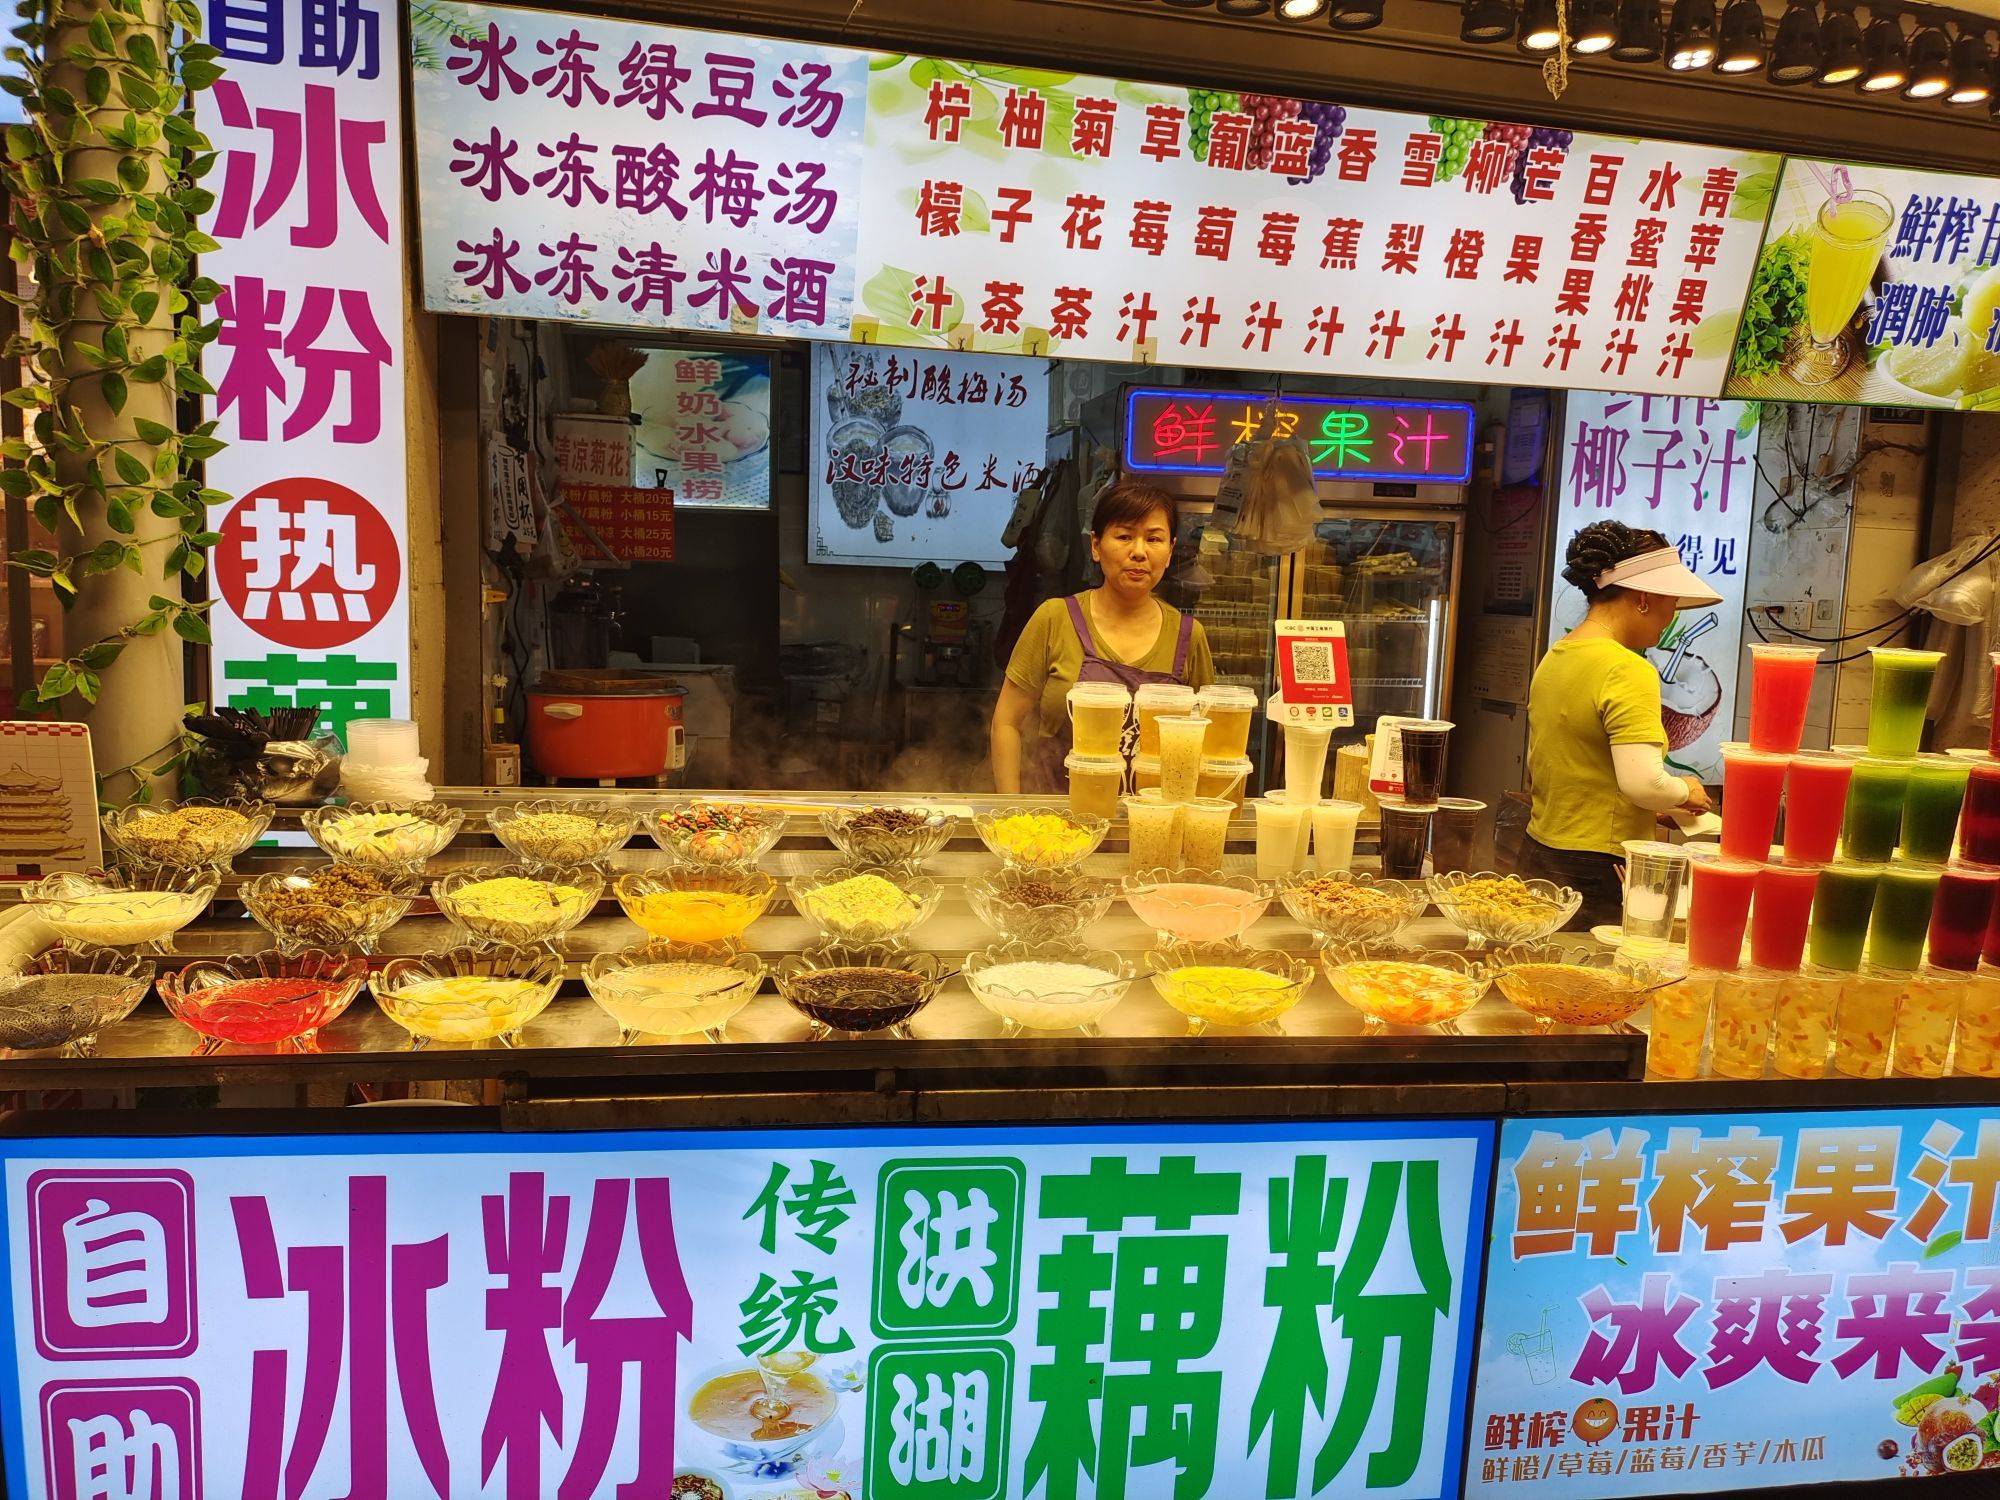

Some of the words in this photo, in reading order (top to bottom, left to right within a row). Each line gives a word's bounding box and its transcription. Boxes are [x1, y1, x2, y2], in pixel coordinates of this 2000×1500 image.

[209, 0, 380, 80] 自助
[447, 22, 844, 138] 冰冻绿豆汤
[210, 83, 393, 444] 冰粉
[449, 127, 838, 234] 冰冻酸梅汤
[452, 227, 836, 326] 冰冻清米酒
[909, 81, 971, 331] 柠檬汁
[980, 88, 1046, 335] 柚子茶
[1050, 97, 1117, 340] 菊花茶
[1117, 105, 1185, 344] 草莓汁
[1181, 113, 1251, 348] 葡萄汁
[1243, 120, 1317, 352] 蓝莓汁
[1304, 128, 1377, 356] 香蕉汁
[1366, 134, 1441, 360] 雪梨汁
[1427, 138, 1508, 363] 柳橙汁
[1486, 148, 1565, 367] 芒果汁
[1544, 154, 1623, 371] 百香果汁
[1601, 161, 1681, 376] 水蜜桃汁
[1657, 166, 1738, 380] 青苹果汁
[554, 435, 632, 478] 清凉菊花
[674, 359, 723, 500] 鲜奶水果捞
[826, 447, 1046, 493] 汉味特色米酒
[845, 354, 1027, 408] 秘制酸梅汤
[1568, 420, 1747, 513] 椰子汁
[240, 497, 376, 621] 热
[620, 492, 672, 505] 大桶20元
[620, 508, 672, 522] 小桶15元
[620, 526, 672, 541] 大桶25元
[620, 545, 672, 559] 小桶20元
[736, 1158, 857, 1358] 传统
[1511, 1119, 2000, 1260] 鲜榨果汁
[62, 1198, 181, 1500] 自助
[229, 1171, 694, 1500] 冰粉
[888, 1187, 999, 1485] 洪湖
[1023, 1154, 1453, 1500] 藕粉
[1484, 1410, 1568, 1450] 鲜榨
[1621, 1402, 1700, 1443] 果汁
[1481, 1436, 1826, 1484] 鲜橙/草莓/蓝莓/香芋/木瓜
